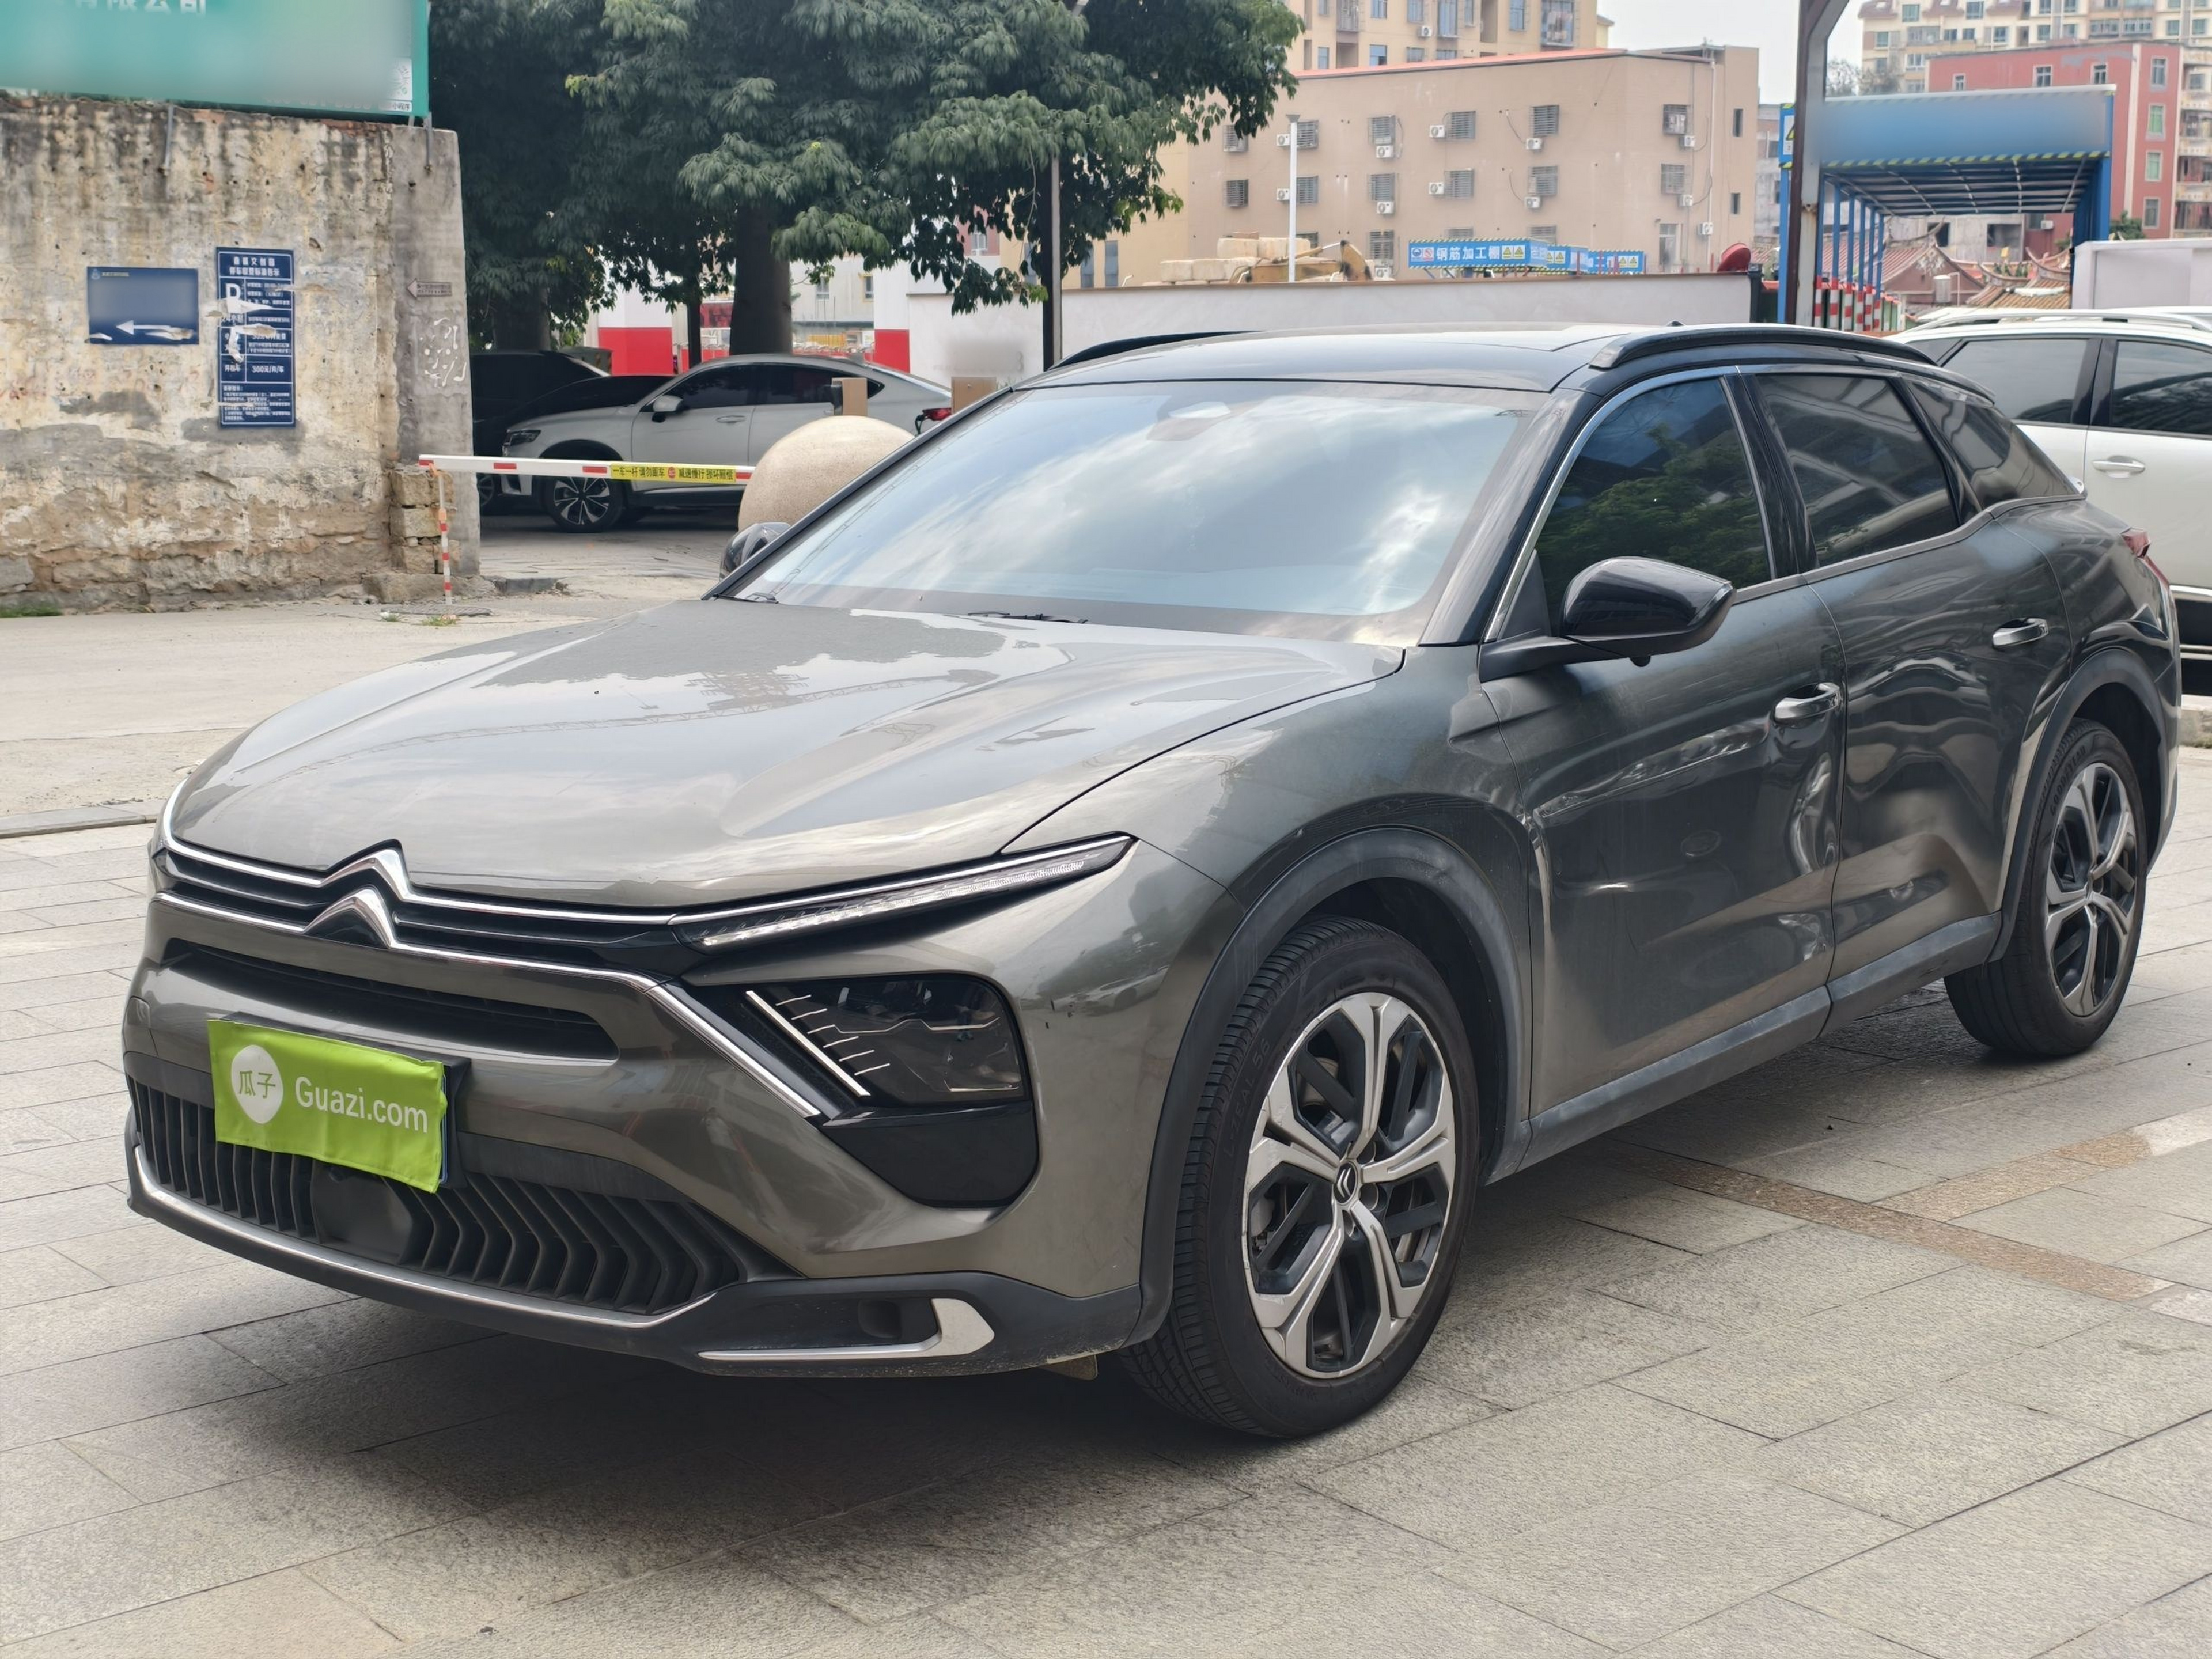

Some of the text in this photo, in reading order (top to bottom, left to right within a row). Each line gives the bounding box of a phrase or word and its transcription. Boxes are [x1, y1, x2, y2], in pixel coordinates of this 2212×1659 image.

[1436, 246, 1501, 261] 钢筋加工棚
[238, 1070, 428, 1134] 瓜子 Guazi.com
